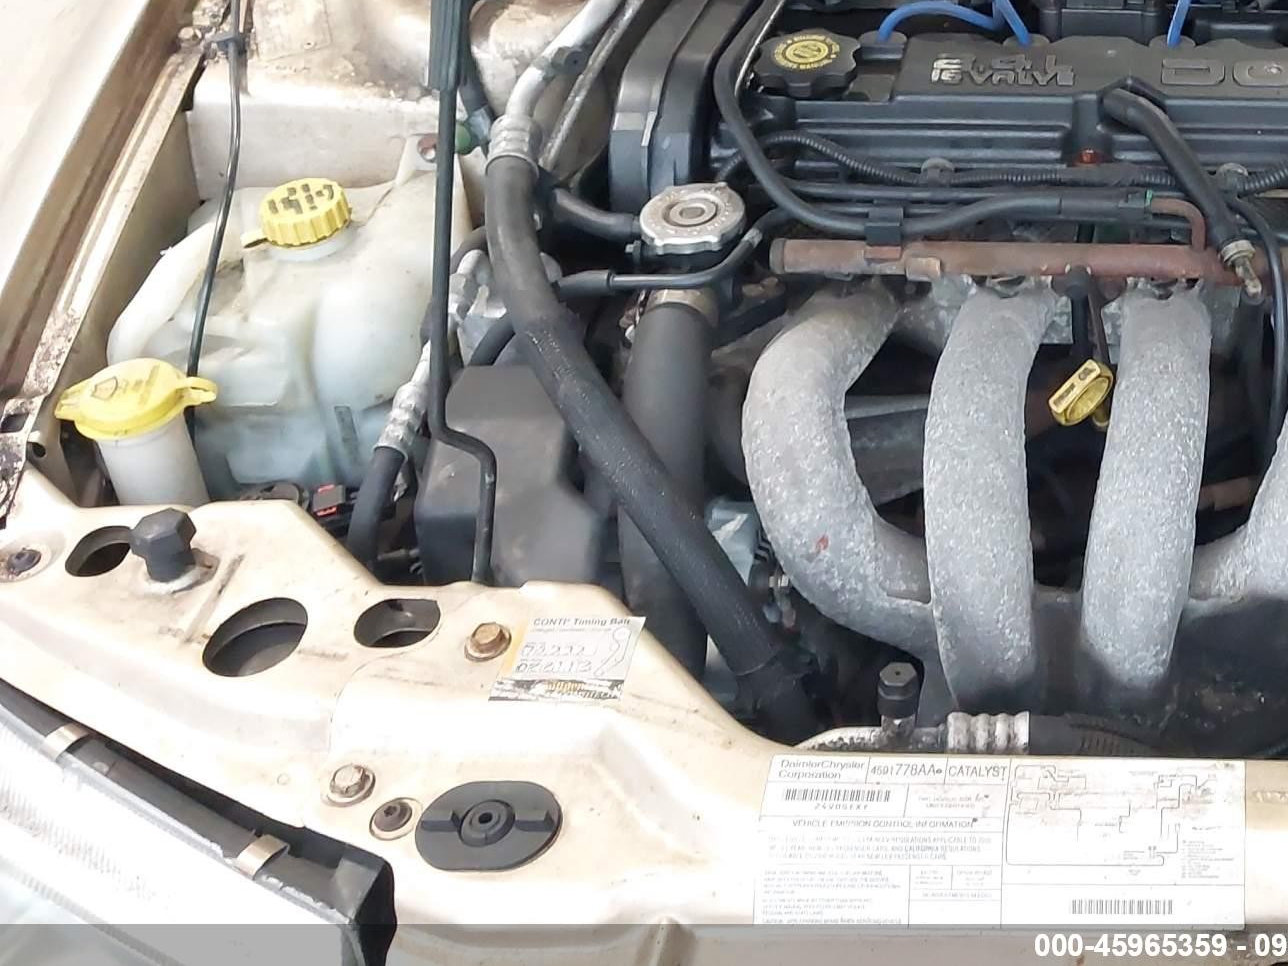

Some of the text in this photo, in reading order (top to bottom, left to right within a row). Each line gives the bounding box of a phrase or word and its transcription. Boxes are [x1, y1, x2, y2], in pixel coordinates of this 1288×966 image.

[574, 618, 607, 627] Timing
[778, 770, 841, 780] Corporation
[948, 765, 1007, 778] CATALYST
[916, 819, 974, 828] INFORMATION
